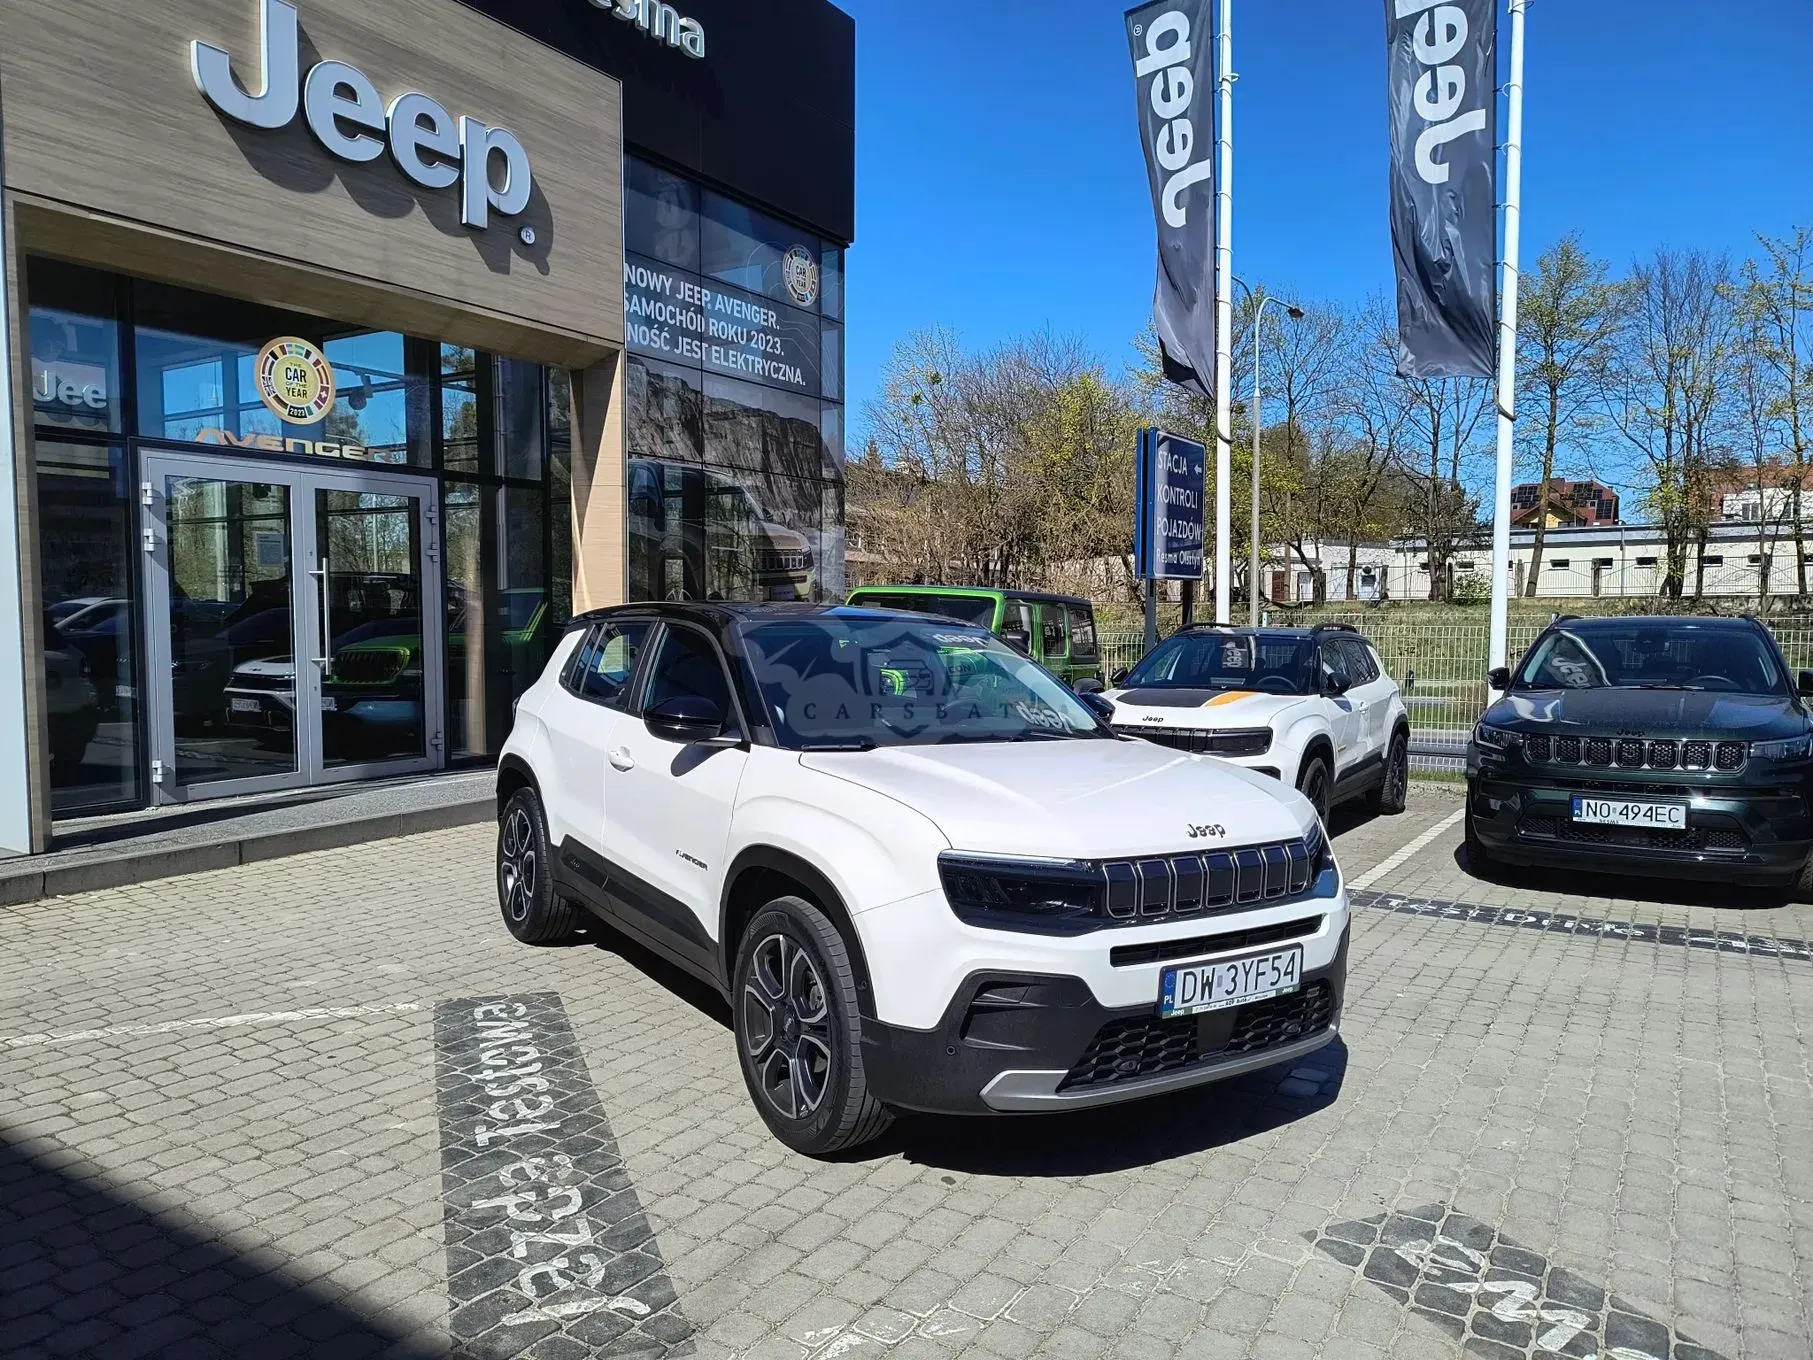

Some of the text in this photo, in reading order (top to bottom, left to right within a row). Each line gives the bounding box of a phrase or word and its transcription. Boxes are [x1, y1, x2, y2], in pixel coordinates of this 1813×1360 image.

[190, 0, 531, 230] Jeep
[624, 262, 672, 296] NOWY
[715, 296, 780, 331] AVENGER.
[709, 318, 747, 345] ROKU
[750, 330, 784, 356] 2023.
[674, 336, 707, 361] JEST
[711, 346, 806, 386] ELEKTRYCZNA.
[285, 366, 307, 383] CAR
[286, 386, 308, 399] YEAR
[1157, 451, 1188, 475] STACJA
[1156, 483, 1198, 509] KONTROLI
[1156, 516, 1200, 541] POJAZDÓW
[1156, 548, 1200, 570] Resma Olsztyn
[1142, 715, 1164, 723] Jeep
[1586, 801, 1680, 823] NO 494EC
[1186, 823, 1226, 838] Jeep
[1181, 951, 1296, 1005] DW 3YF54
[1163, 994, 1174, 1005] PL
[1170, 1008, 1185, 1016] Jeep
